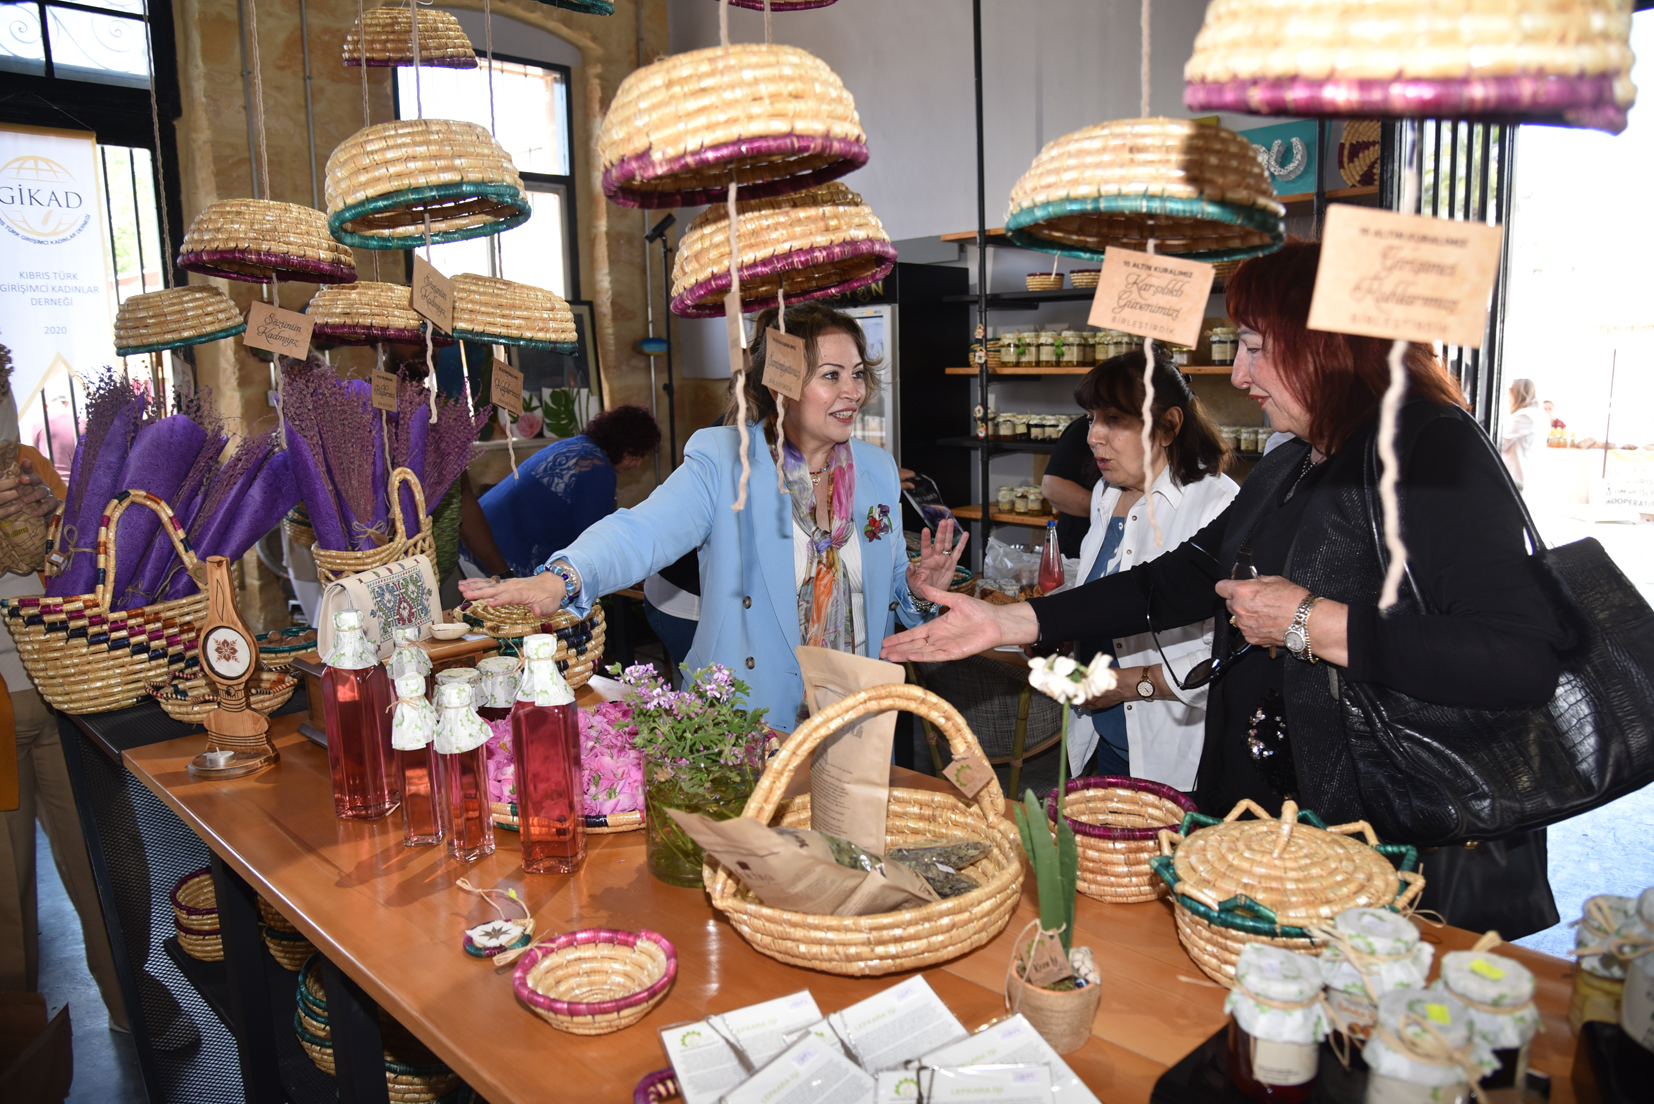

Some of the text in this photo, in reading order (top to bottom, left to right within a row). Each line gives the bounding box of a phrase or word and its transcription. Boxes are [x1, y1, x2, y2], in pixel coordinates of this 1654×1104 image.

[0, 184, 83, 209] GİKAD
[4, 224, 20, 237] TÜRK
[20, 234, 50, 246] GİRİŞİMCİ
[50, 232, 77, 245] KADINLAR
[19, 270, 79, 281] KIBRIS TÜRK
[1132, 261, 1152, 272] ALTIN
[1153, 265, 1194, 279] KURALIMIZ
[0, 282, 100, 295] GİRİŞİMCİ KADINLAR
[30, 296, 74, 307] DERNEĞİ
[1111, 289, 1181, 321] Güvenimizi
[44, 325, 68, 335] 2020
[1111, 315, 1176, 336] BİRLEŞTİRDİK
